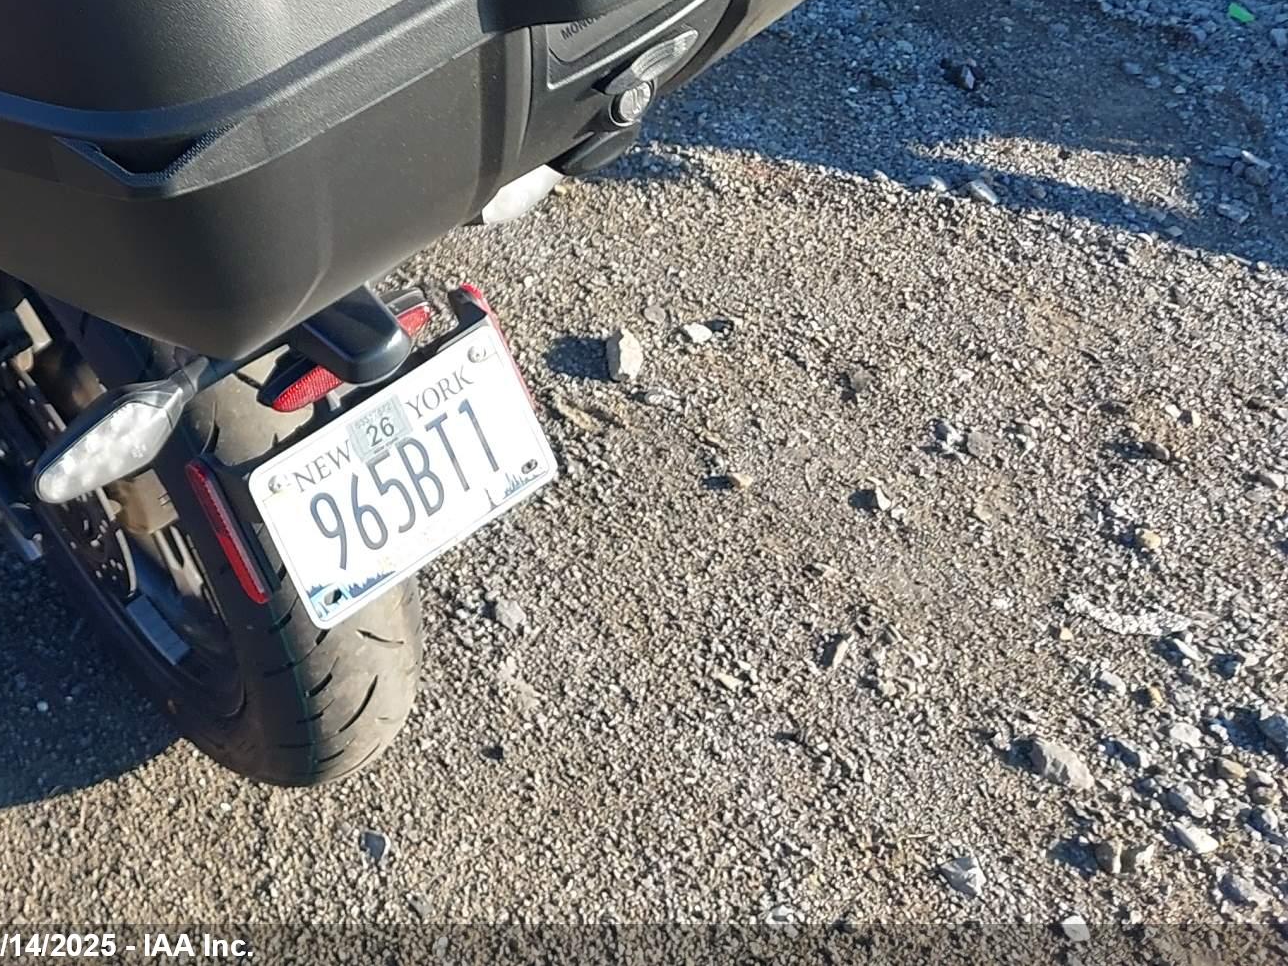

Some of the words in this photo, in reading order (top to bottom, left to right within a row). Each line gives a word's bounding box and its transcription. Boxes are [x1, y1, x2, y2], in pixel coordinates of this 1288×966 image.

[292, 439, 352, 494] NEW
[405, 368, 475, 421] YORK
[309, 398, 501, 571] 965BT1
[366, 416, 395, 447] 26
